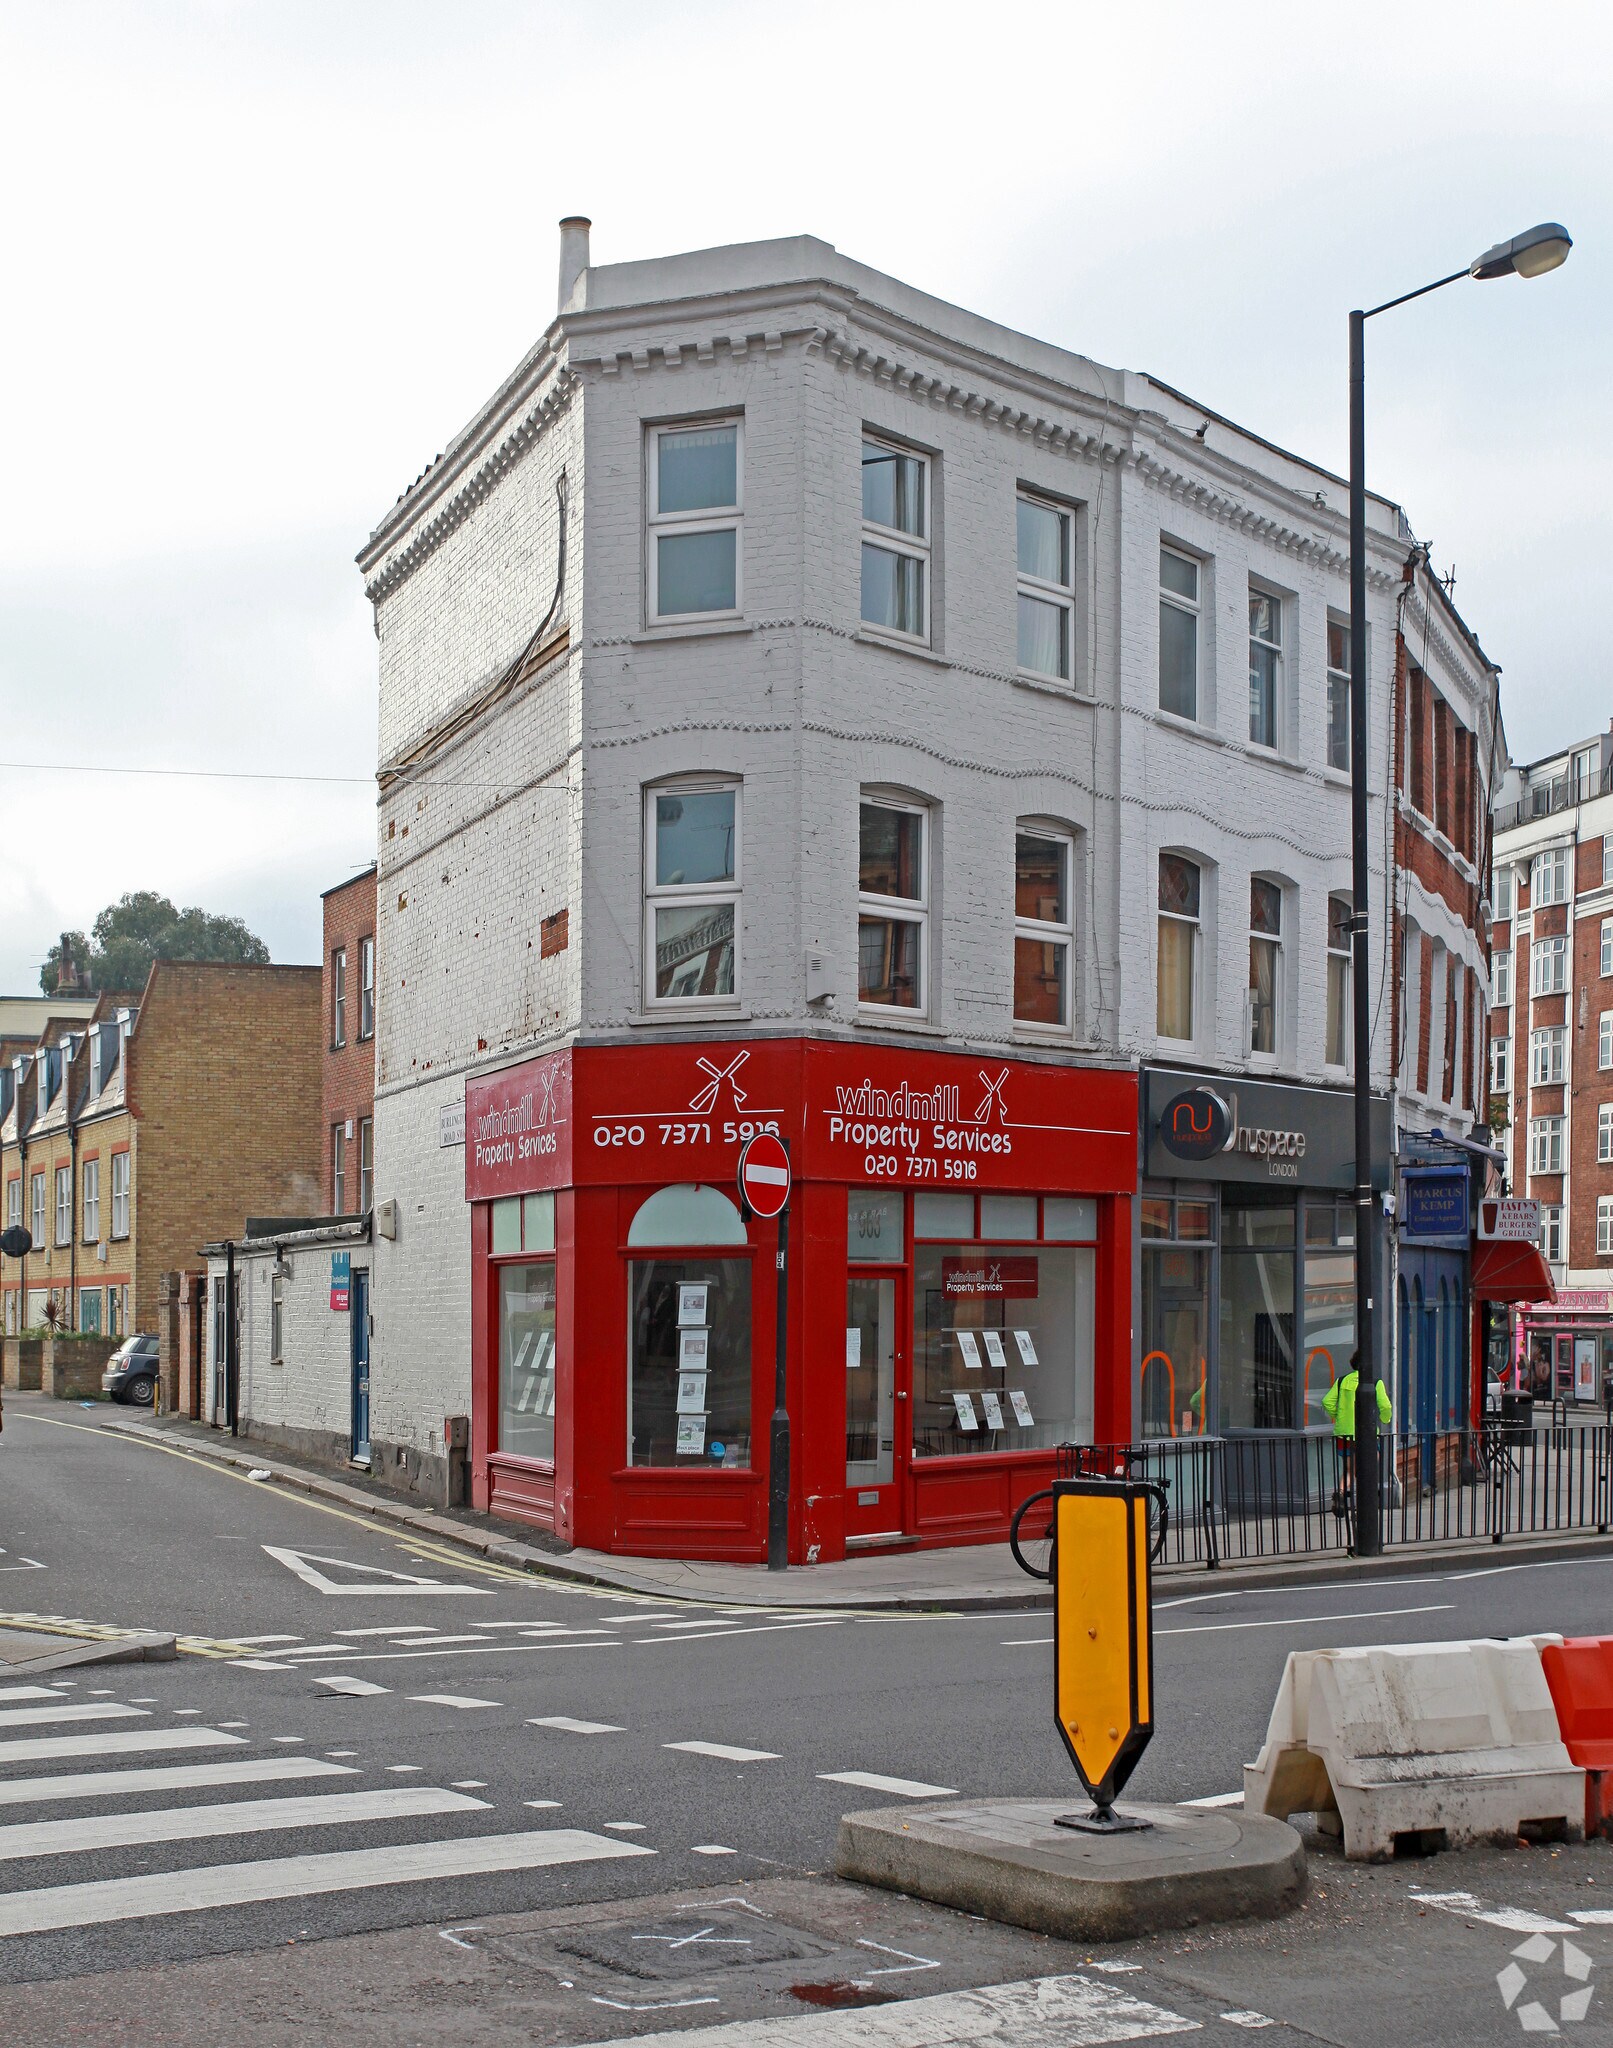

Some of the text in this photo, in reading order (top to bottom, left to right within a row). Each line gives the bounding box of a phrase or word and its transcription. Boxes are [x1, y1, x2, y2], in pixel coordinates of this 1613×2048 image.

[836, 1078, 959, 1123] windmill
[478, 1092, 533, 1141] windmill
[593, 1125, 645, 1147] 020
[658, 1123, 711, 1145] 7371
[830, 1117, 1012, 1154] Property Services
[476, 1131, 557, 1169] Property Services
[1238, 1126, 1306, 1162] nuspace
[864, 1154, 977, 1180] 020 7371 5916
[1268, 1163, 1298, 1177] LONDON
[1413, 1187, 1462, 1199] MARCUS
[1421, 1201, 1455, 1211] KEMP
[1500, 1201, 1538, 1212] TASTY'S
[1502, 1212, 1534, 1220] KEBABS
[1498, 1221, 1537, 1229] BURGERS
[1502, 1230, 1532, 1238] GRILLS
[948, 1269, 985, 1283] windmill
[946, 1283, 1003, 1293] Property Services
[1578, 1292, 1607, 1306] NAILS
